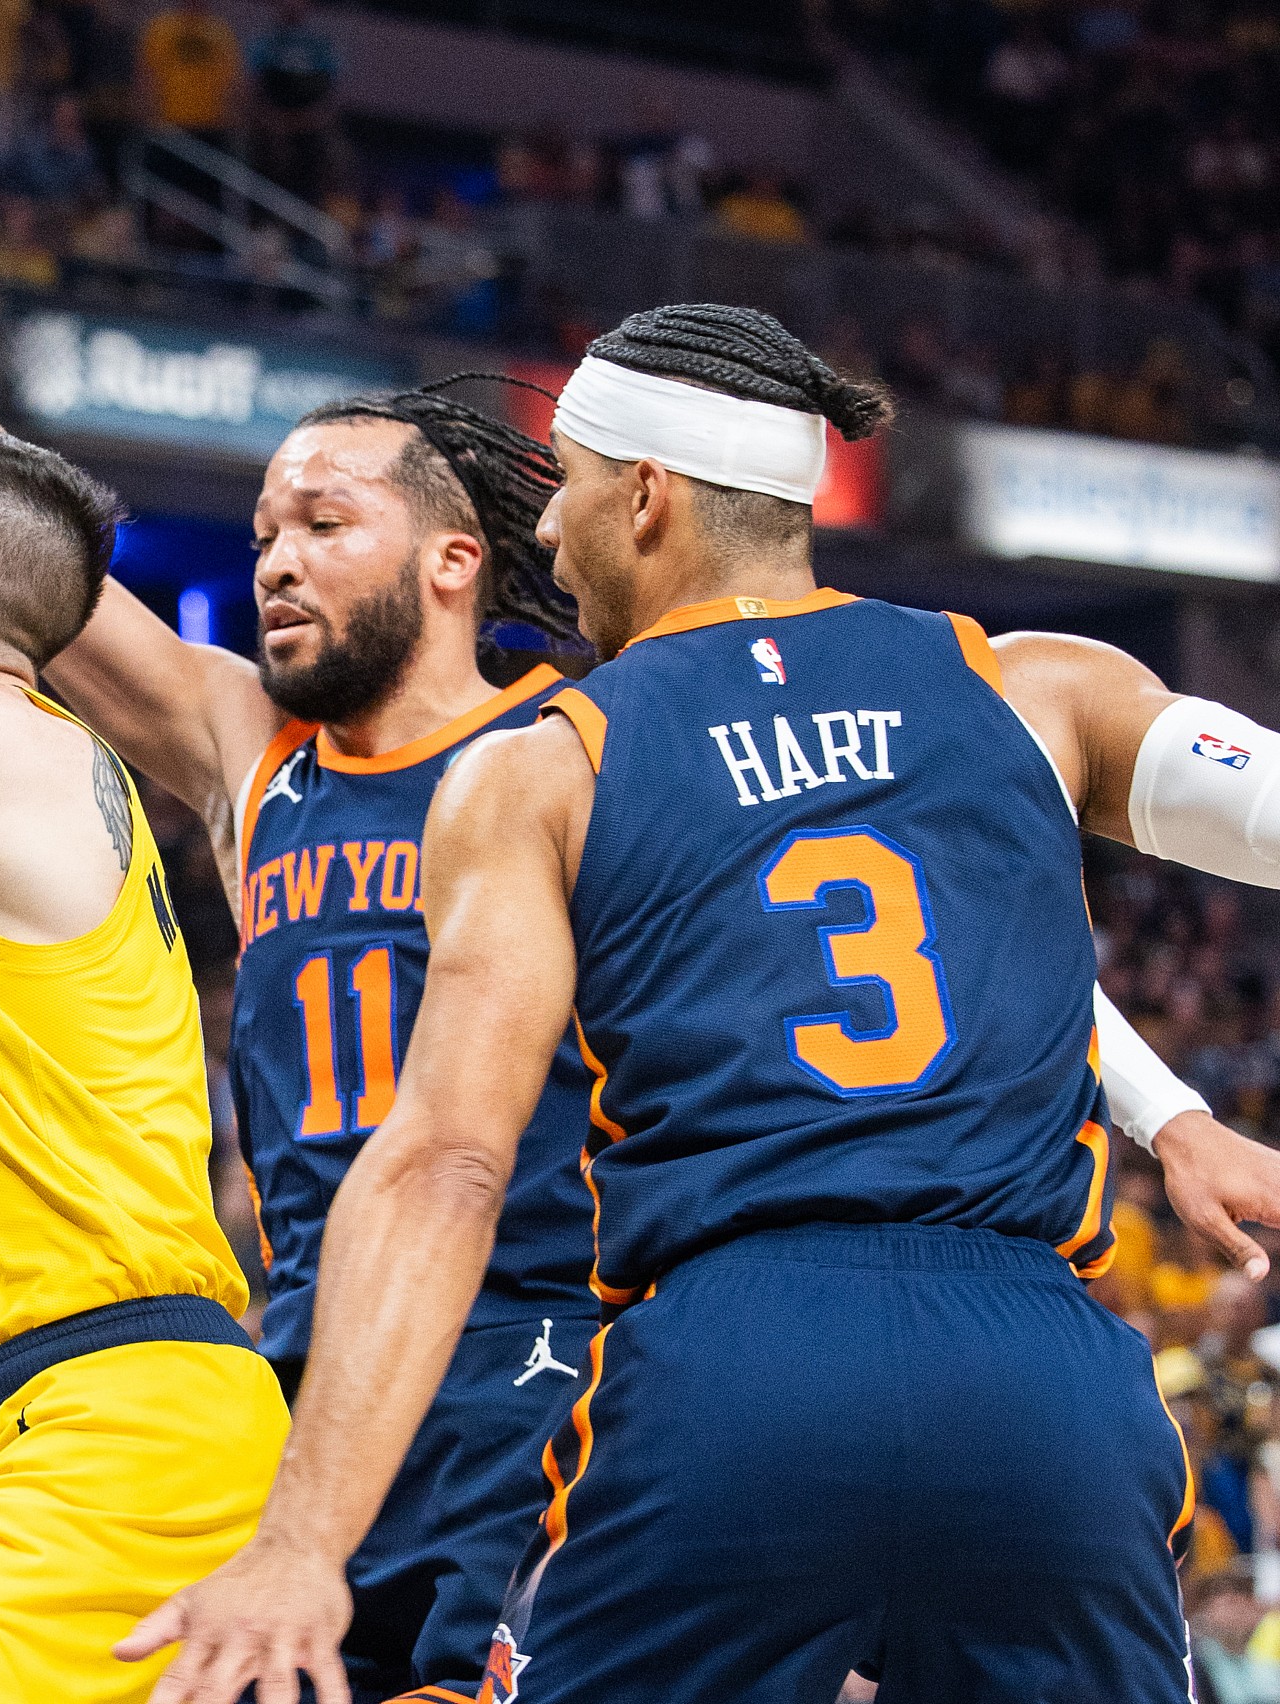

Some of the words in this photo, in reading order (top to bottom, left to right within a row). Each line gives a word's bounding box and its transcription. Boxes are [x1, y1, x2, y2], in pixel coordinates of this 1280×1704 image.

[708, 709, 902, 806] HART
[240, 843, 335, 954] NEW
[342, 841, 426, 912] YO
[756, 823, 958, 1098] 3
[293, 941, 398, 1141] 11
